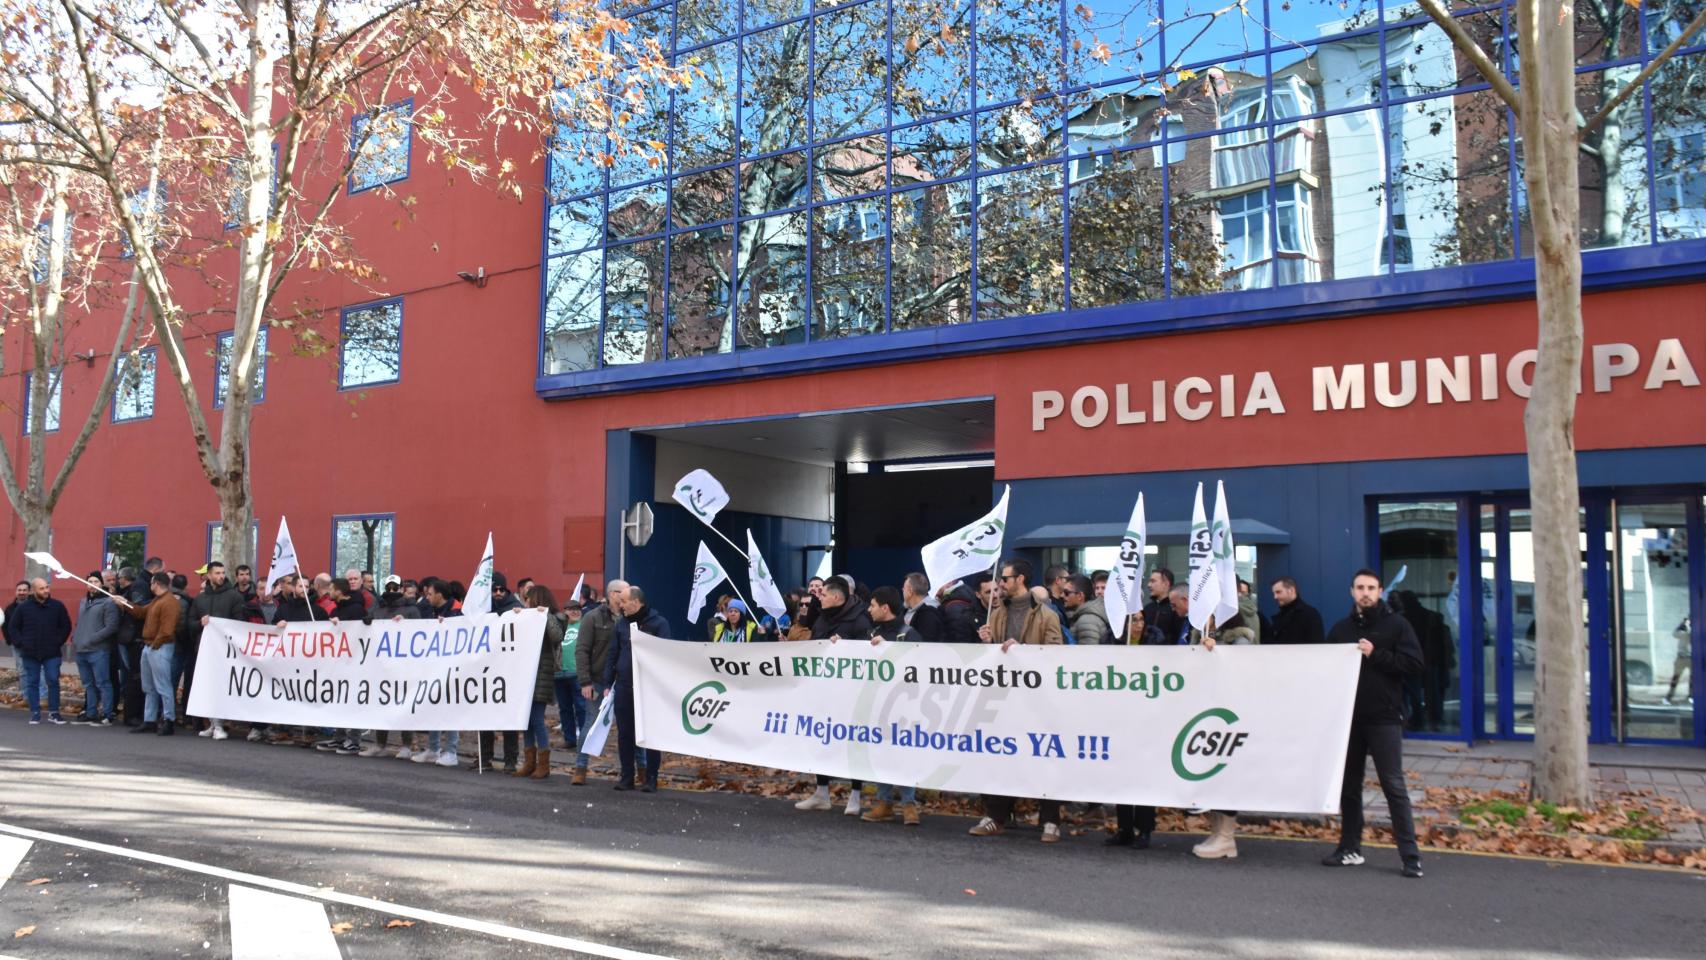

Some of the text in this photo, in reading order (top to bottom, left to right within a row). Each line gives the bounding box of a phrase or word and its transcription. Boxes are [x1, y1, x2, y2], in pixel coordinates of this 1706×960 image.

[1032, 338, 1701, 431] POLICIA MUNICPA
[358, 637, 371, 665] y
[376, 625, 491, 658] ALCALDIA
[501, 622, 515, 652] !!
[228, 666, 507, 714] NO cuidan a su policía
[709, 656, 1185, 699] Por el RESPETO a nuestro trabajo
[688, 696, 731, 720] CSIF
[795, 715, 883, 745] Mejoras
[891, 722, 1018, 756] laborales
[1027, 732, 1066, 759] YA
[1077, 735, 1110, 761] !!!
[1186, 730, 1249, 757] CSIF
